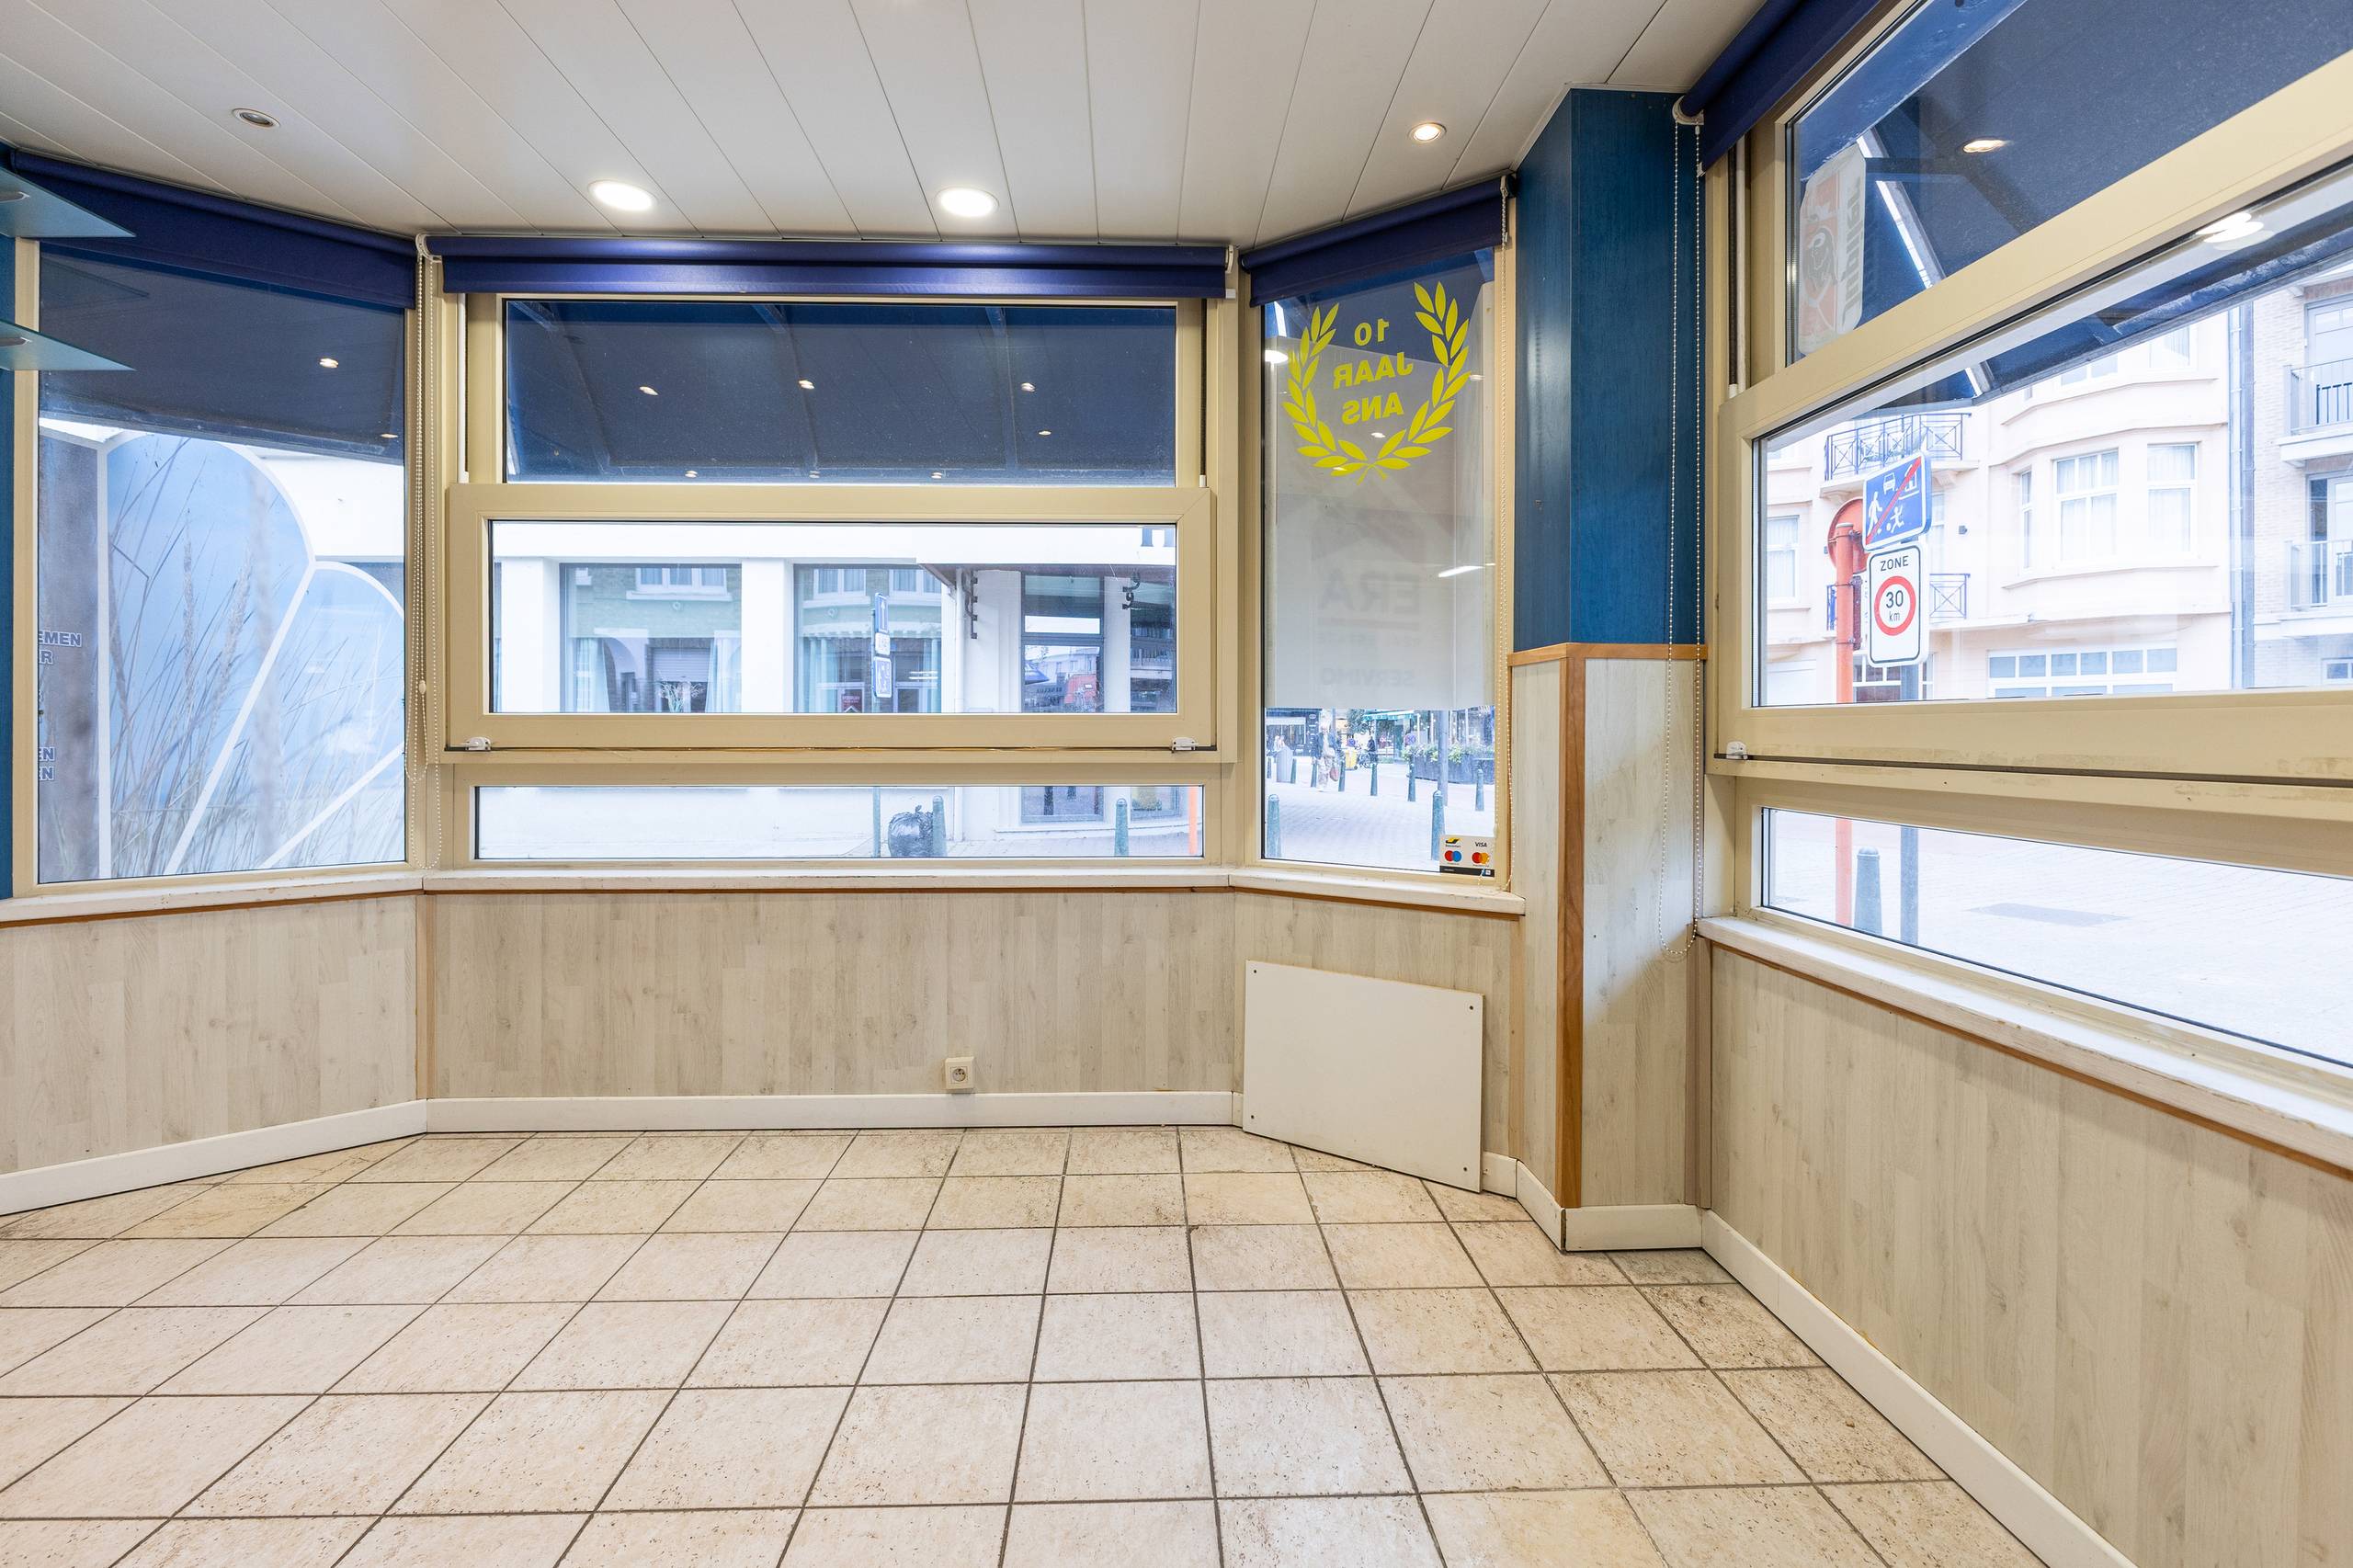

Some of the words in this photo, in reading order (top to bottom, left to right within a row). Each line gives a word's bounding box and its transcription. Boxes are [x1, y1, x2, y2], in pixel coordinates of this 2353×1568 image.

[1880, 555, 1909, 572] ZONE
[1885, 589, 1904, 608] 30
[1889, 610, 1901, 622] km
